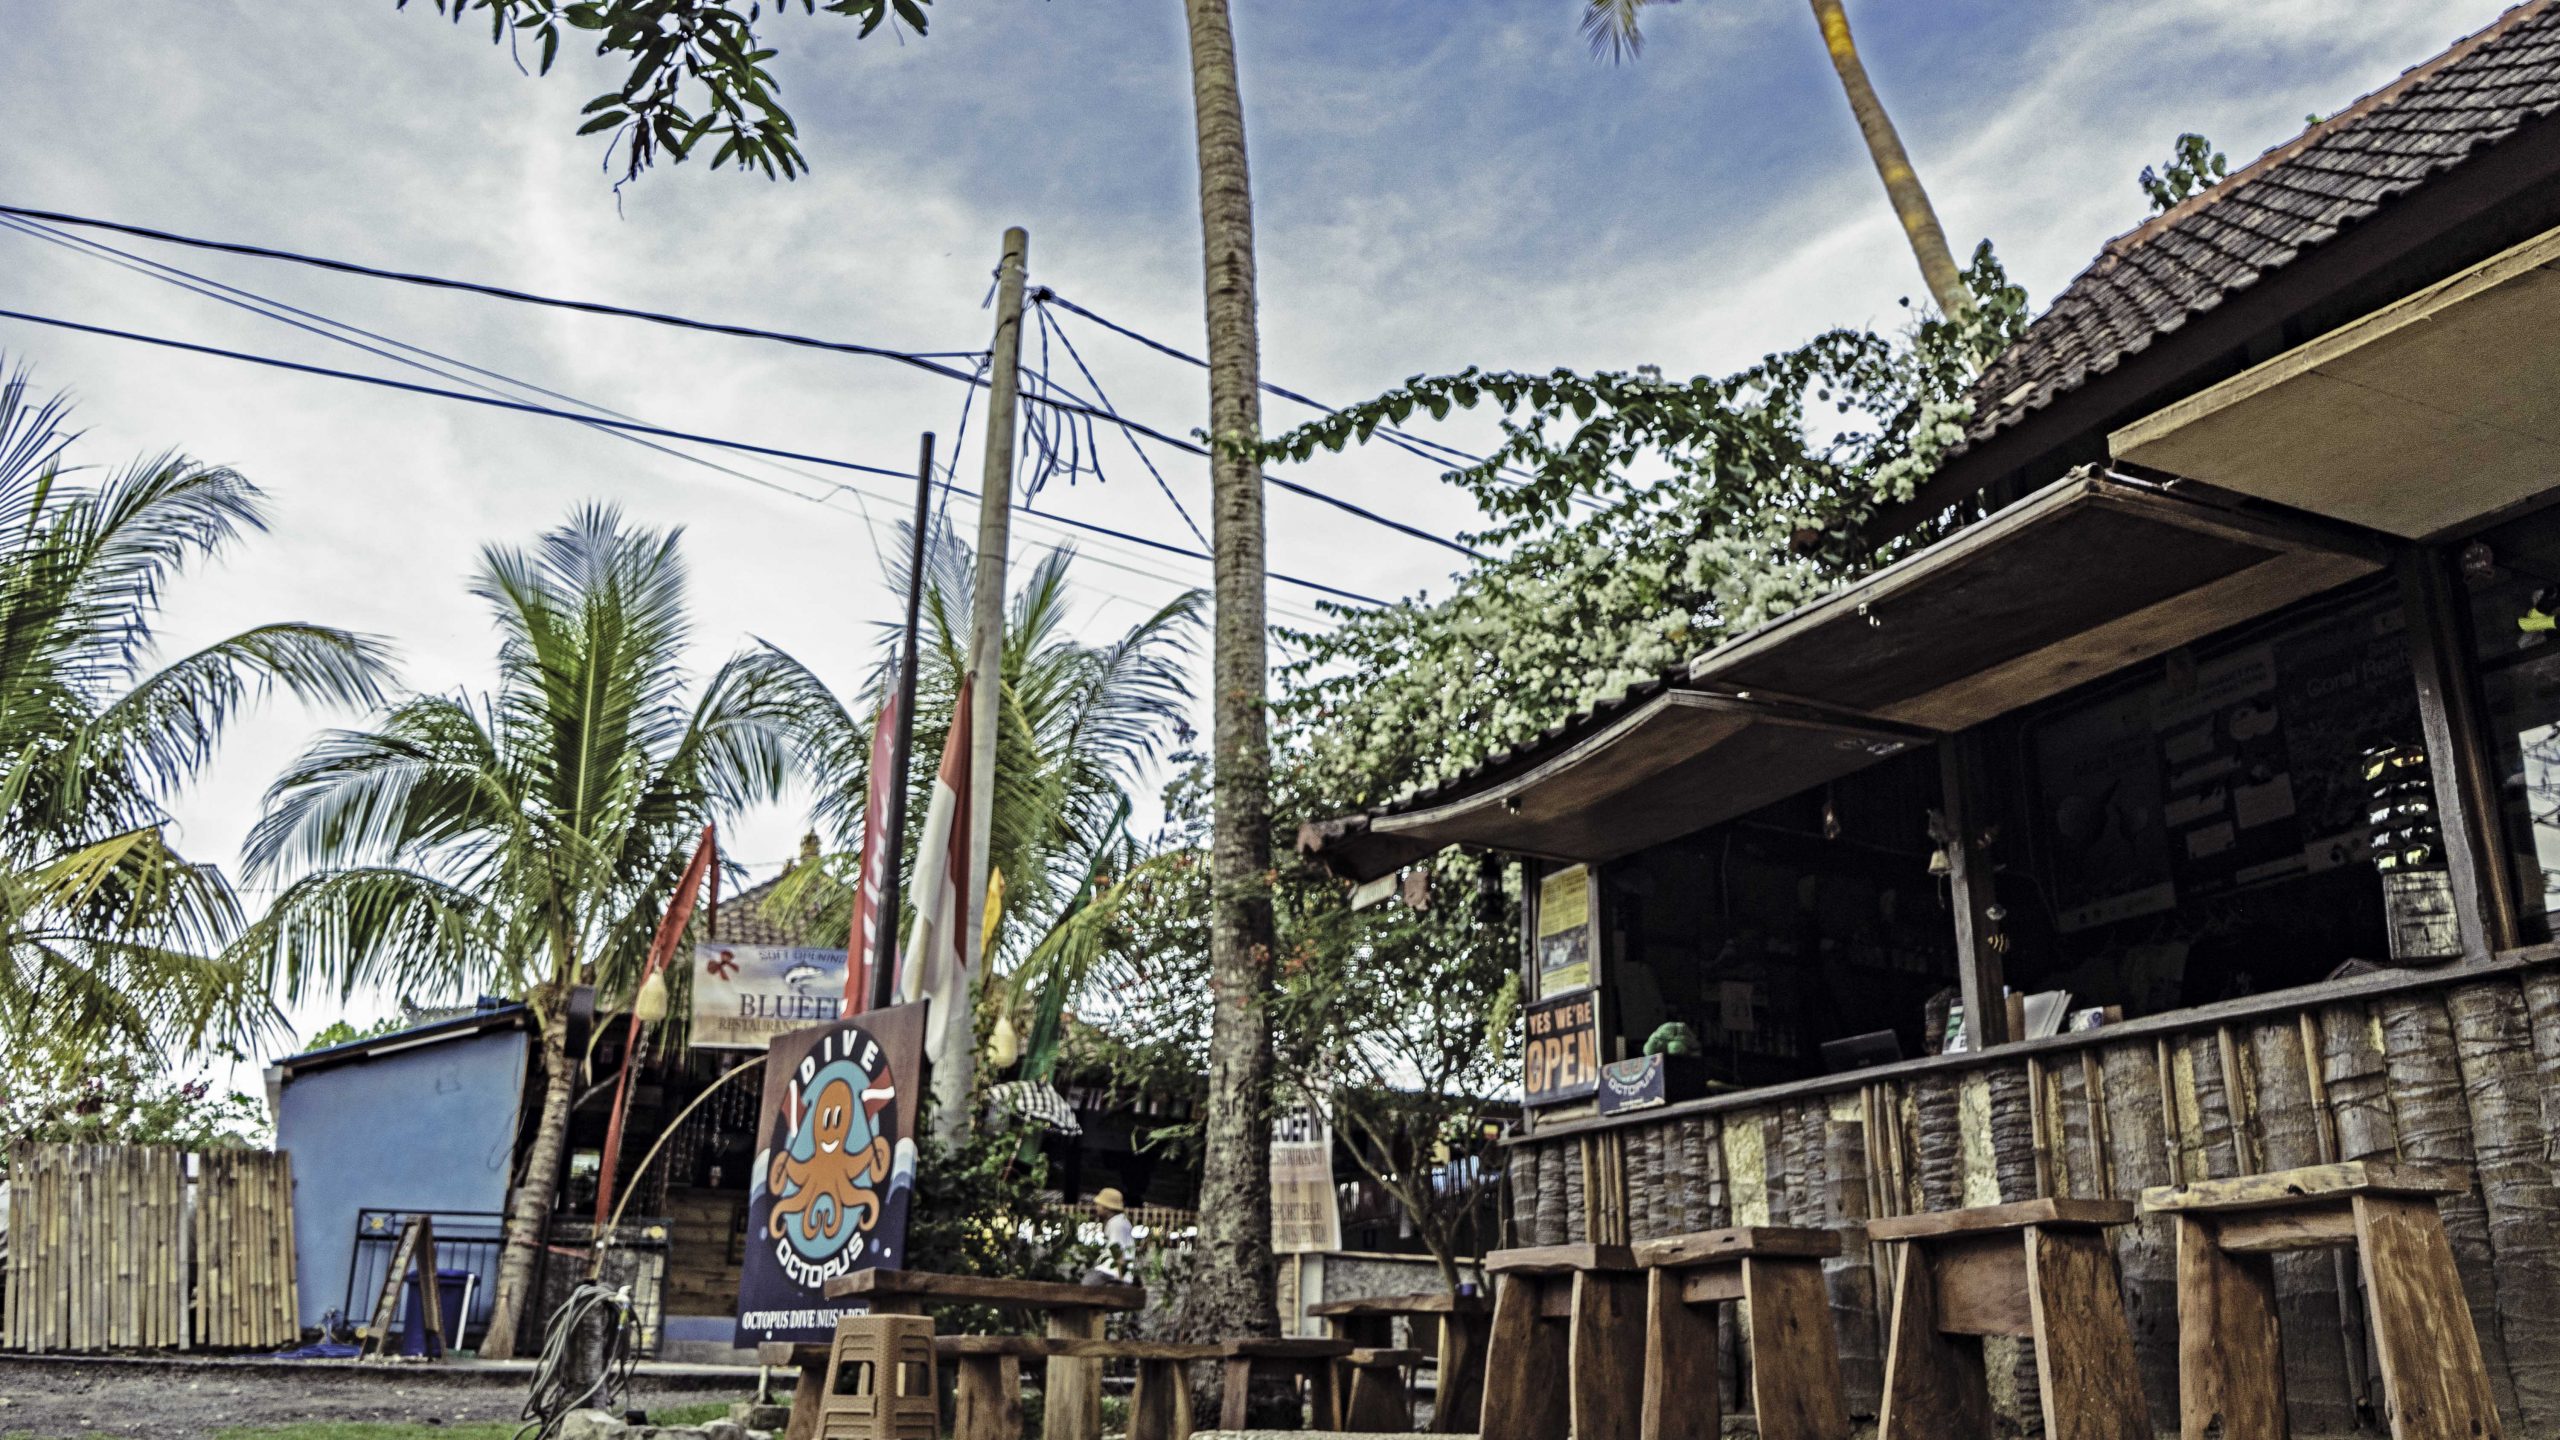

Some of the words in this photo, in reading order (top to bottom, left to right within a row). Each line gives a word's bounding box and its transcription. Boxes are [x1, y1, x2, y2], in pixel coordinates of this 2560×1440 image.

[740, 992, 840, 1020] BLUEFI
[1529, 1010, 1552, 1035] YES
[1554, 1000, 1593, 1030] WE'RE
[800, 1029, 879, 1085] DIVE
[1526, 1028, 1596, 1094] OPEN
[776, 1231, 864, 1289] OCTOPUS
[742, 1310, 789, 1330] OCTOPUS
[789, 1309, 815, 1329] DIVE
